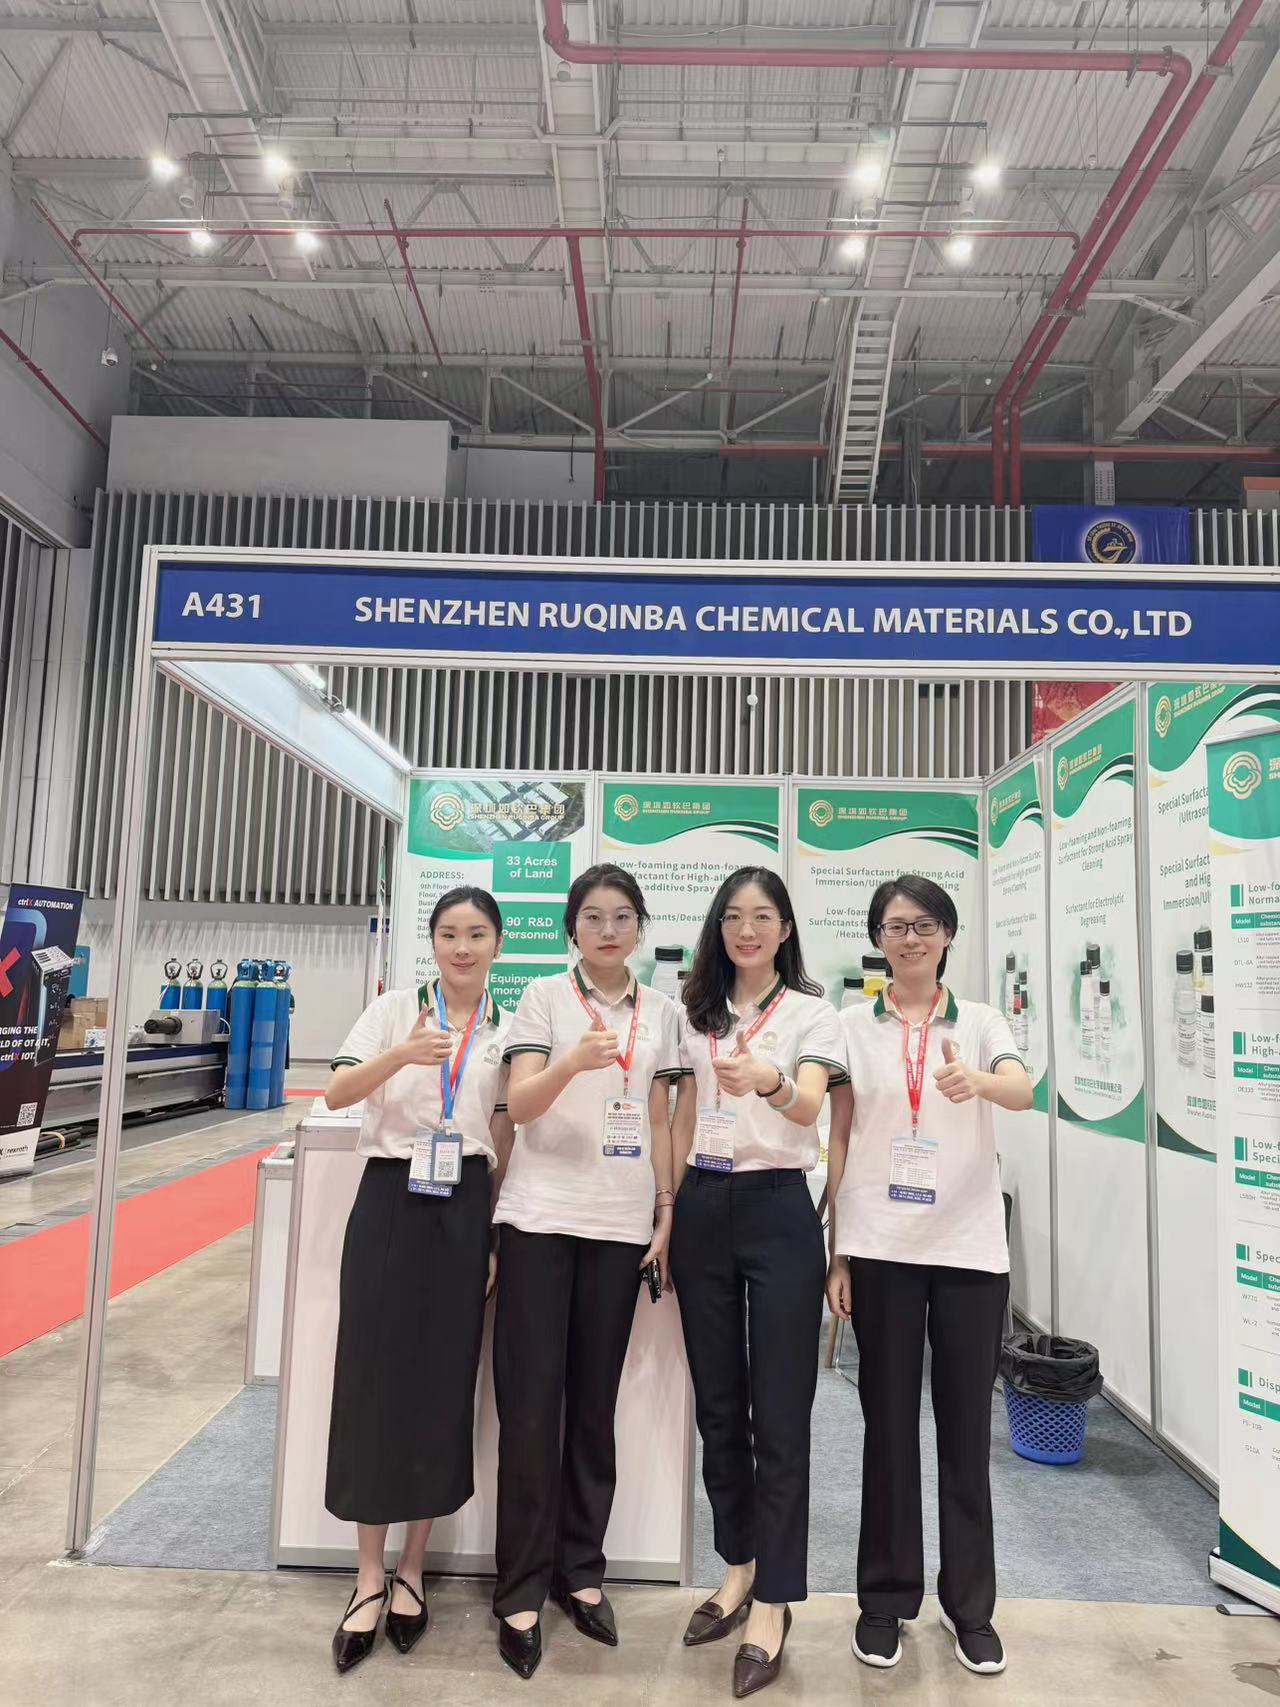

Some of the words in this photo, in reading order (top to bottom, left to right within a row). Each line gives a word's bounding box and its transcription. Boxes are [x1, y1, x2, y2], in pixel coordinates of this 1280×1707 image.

[181, 591, 261, 619] A431
[354, 596, 530, 629] SHENZHEN
[539, 602, 686, 633] RUQINBA
[696, 605, 864, 634] CHEMICAL
[873, 607, 1060, 637] MATERIALS
[1067, 608, 1193, 640] CO.,LTD
[506, 856, 520, 866] 33
[524, 856, 558, 867] Acres
[680, 862, 699, 871] and
[510, 868, 522, 878] of
[525, 868, 553, 878] Land
[810, 866, 844, 876] Special
[846, 867, 894, 877] Surfactant
[912, 869, 943, 880] Strong
[944, 870, 965, 879] Acid
[1160, 859, 1183, 878] Special
[420, 871, 465, 880] ADDRESS:
[671, 872, 685, 881] for
[1185, 873, 1198, 888] and
[687, 884, 716, 894] Spray
[34, 899, 74, 910] AUTOMATION
[528, 917, 553, 927] R&D
[809, 918, 859, 927] Surfactants
[502, 929, 559, 940] Personnel
[493, 987, 521, 995] more
[24, 1026, 38, 1034] THE
[12, 1040, 23, 1048] OF
[24, 1039, 35, 1047] OT
